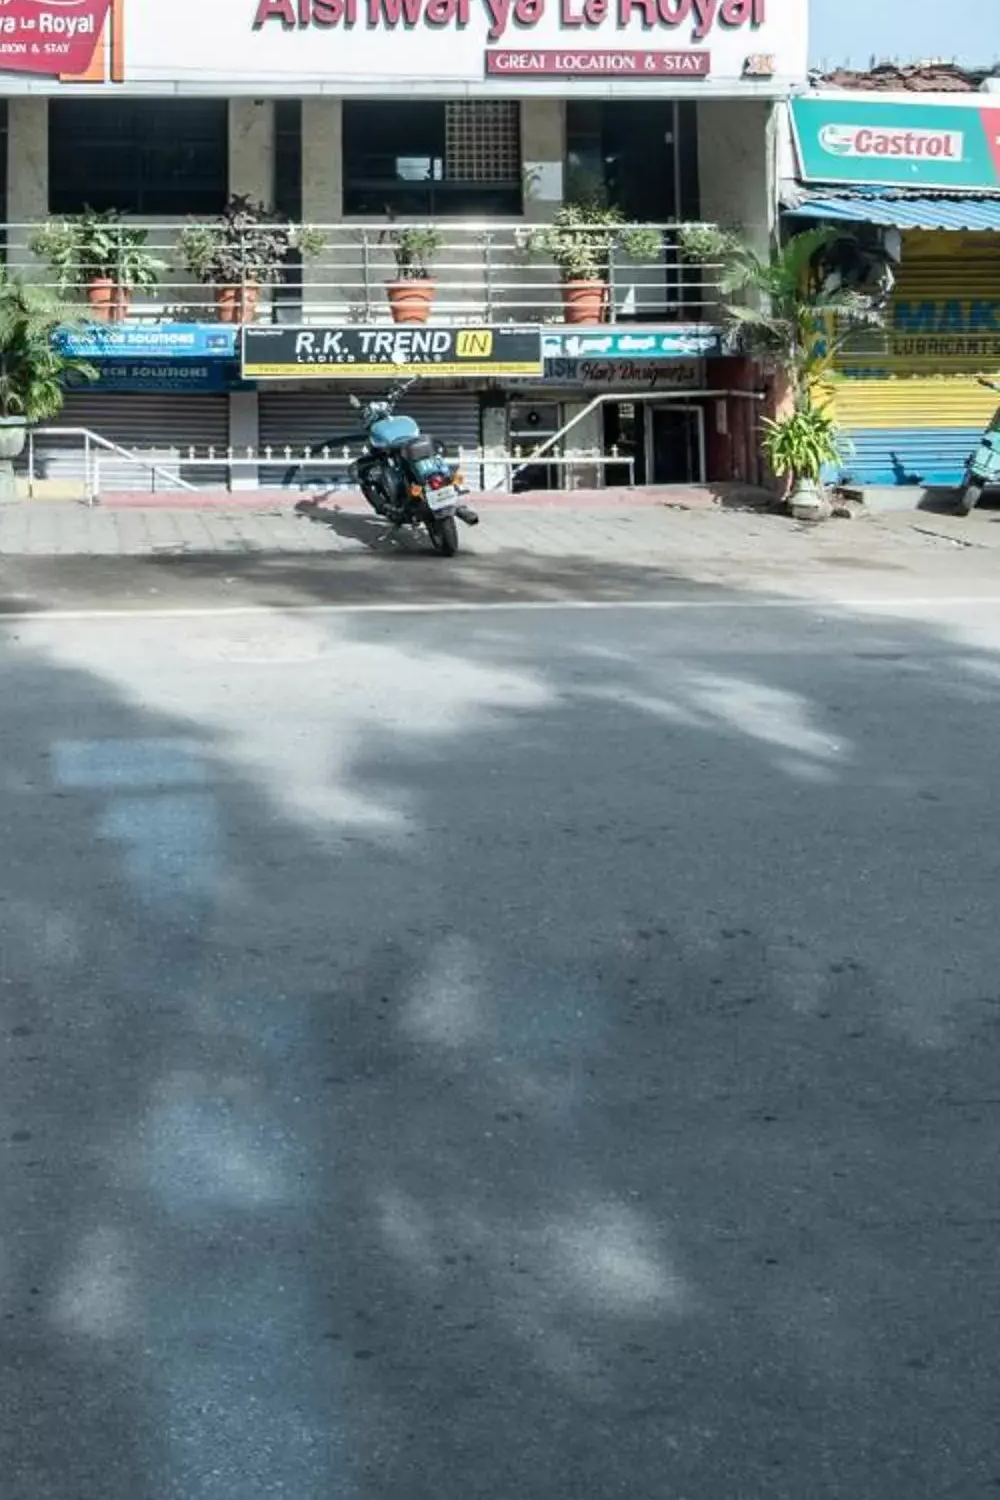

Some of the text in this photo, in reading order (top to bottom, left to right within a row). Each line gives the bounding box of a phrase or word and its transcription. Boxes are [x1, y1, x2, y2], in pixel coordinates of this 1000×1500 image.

[20, 18, 36, 30] Le
[39, 13, 95, 37] Royal
[32, 44, 40, 53] &
[43, 43, 70, 54] STAY
[495, 53, 703, 71] GREAT LOCATION & STAY
[854, 129, 955, 158] Castrol
[295, 331, 489, 354] R.K. TREND IN
[296, 355, 355, 363] LADIES
